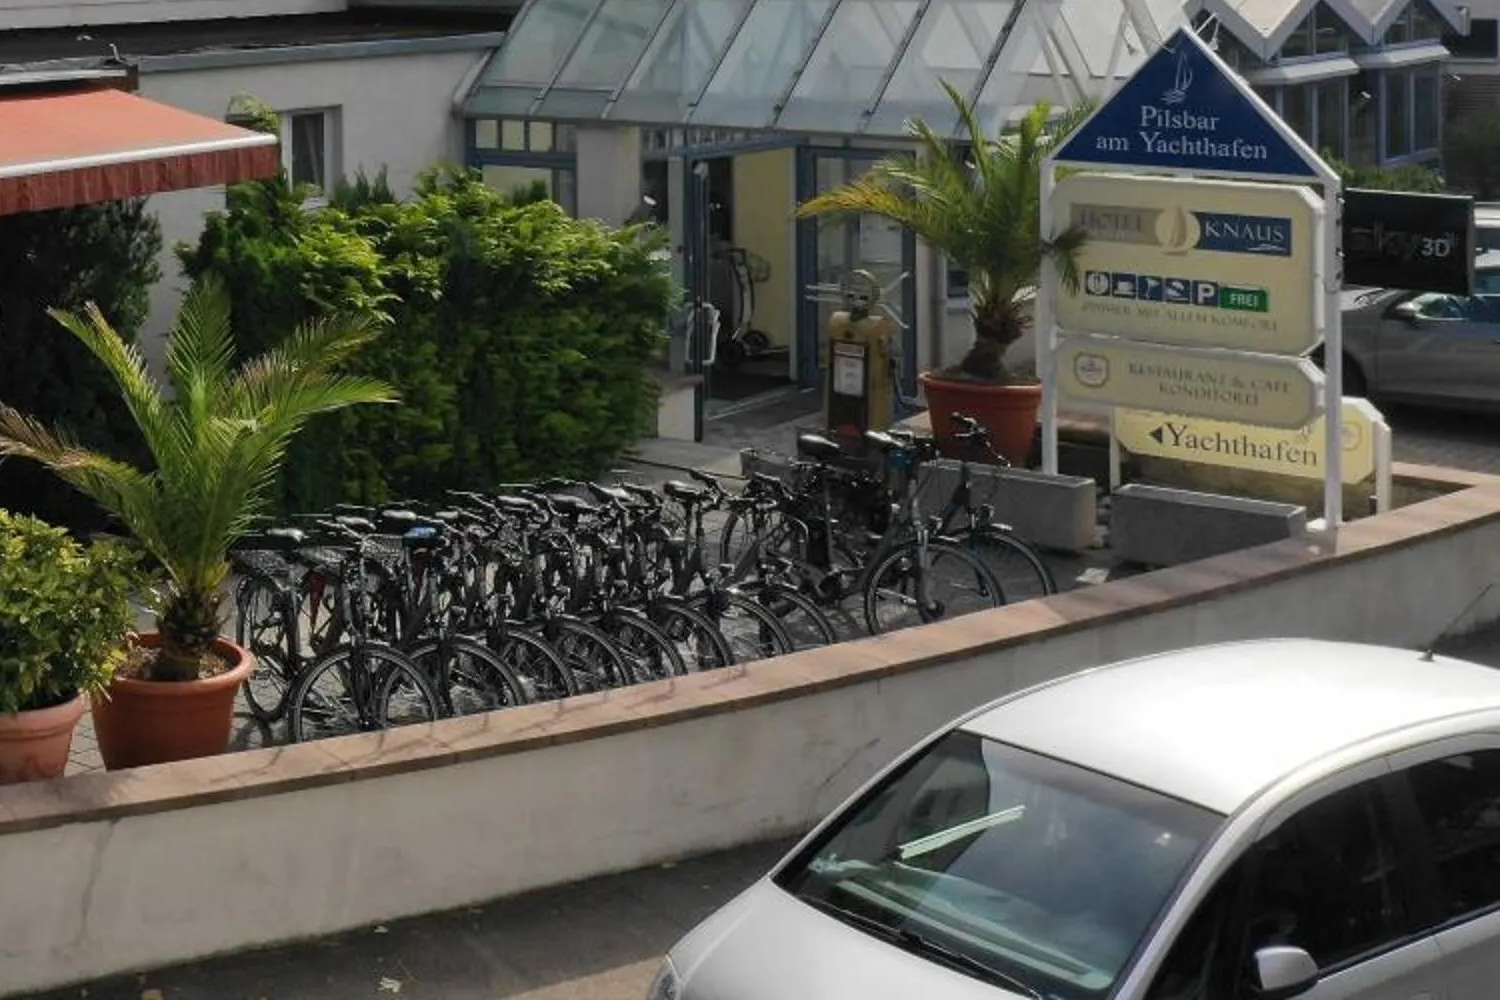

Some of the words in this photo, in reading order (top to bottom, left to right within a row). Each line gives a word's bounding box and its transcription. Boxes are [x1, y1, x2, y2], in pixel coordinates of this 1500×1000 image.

[1139, 105, 1221, 131] Pilsbar
[1095, 135, 1129, 151] am
[1139, 131, 1268, 160] Yachthafen
[1204, 221, 1286, 242] KNAUS
[1420, 237, 1451, 257] 3D
[1228, 292, 1259, 307] FREI
[1127, 361, 1226, 386] RESTAURANT
[1164, 421, 1319, 467] Yachthafen
